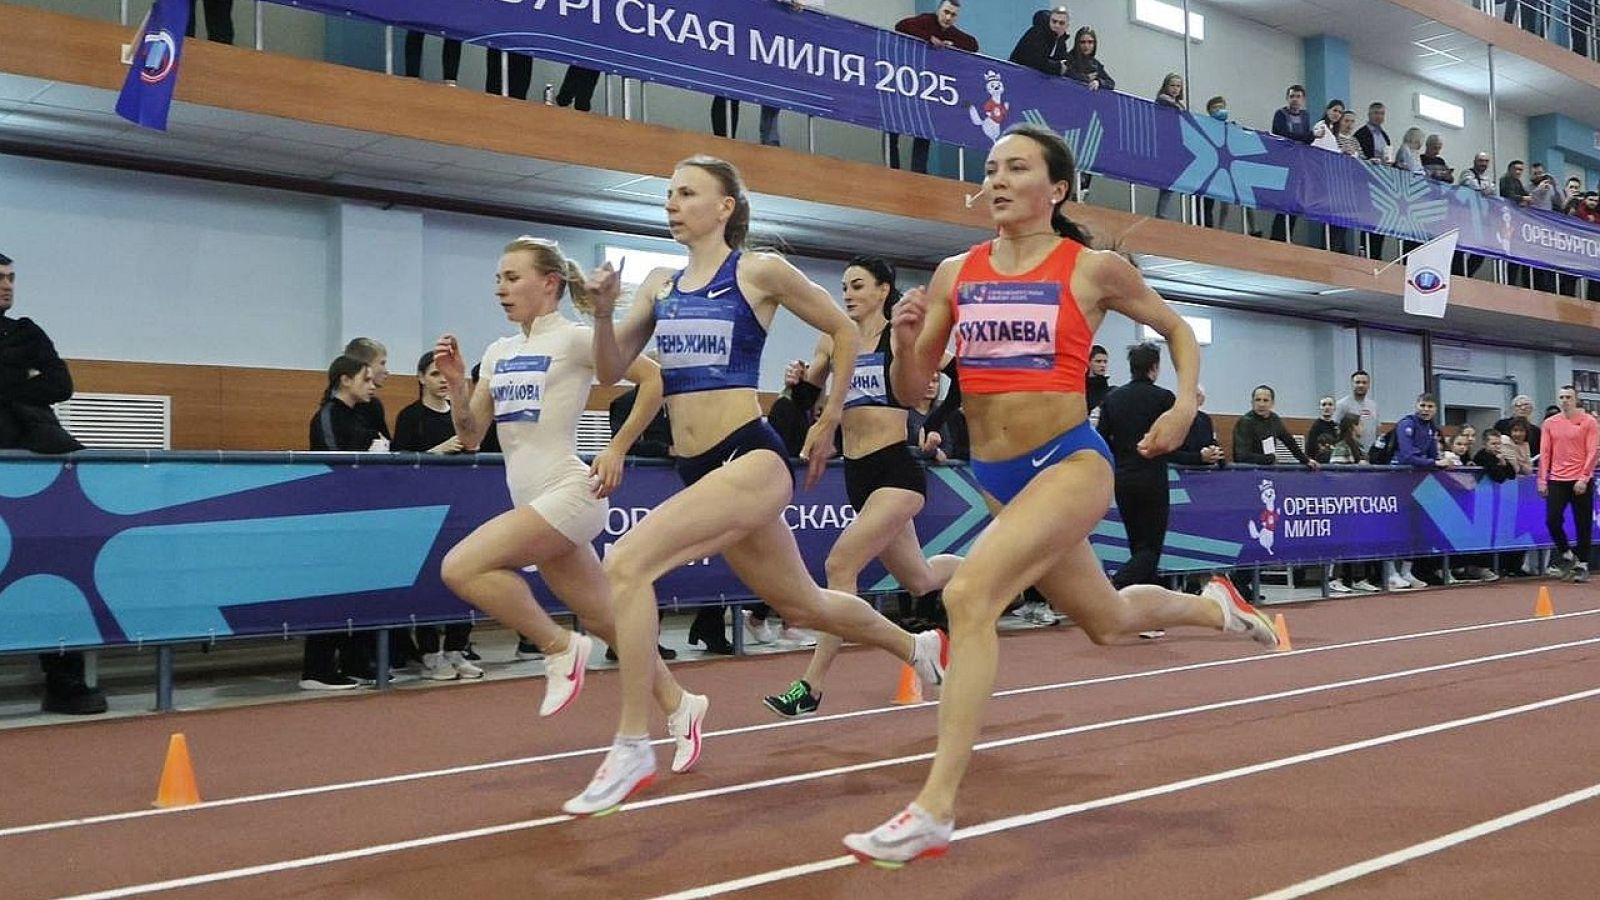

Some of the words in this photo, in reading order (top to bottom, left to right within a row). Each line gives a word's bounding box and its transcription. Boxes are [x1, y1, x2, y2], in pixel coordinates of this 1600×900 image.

[749, 29, 866, 86] МИЛЯ
[874, 60, 960, 106] 2025
[959, 320, 1051, 343] УХТАЕВА
[848, 374, 880, 390] ИНА
[1283, 496, 1398, 516] ОРЕНБУРГСКАЯ
[1284, 519, 1331, 538] МИЛЯ
